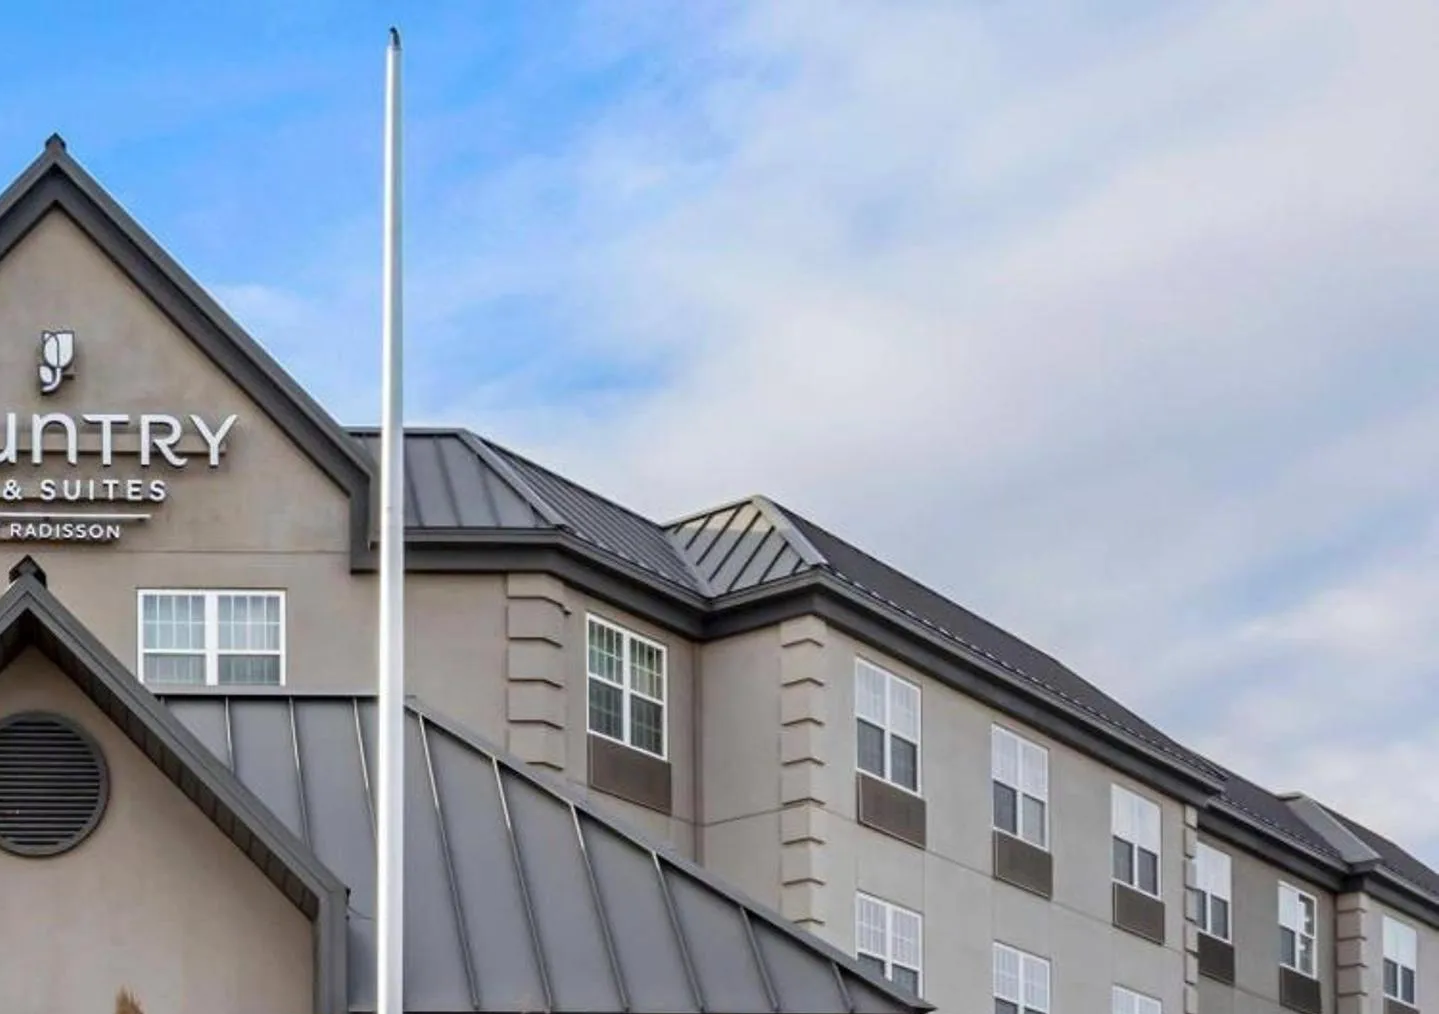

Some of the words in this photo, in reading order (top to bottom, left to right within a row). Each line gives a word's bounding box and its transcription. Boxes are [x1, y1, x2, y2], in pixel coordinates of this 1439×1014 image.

[2, 479, 23, 501] &
[40, 478, 168, 502] SUITES
[9, 523, 122, 541] RADISSON
